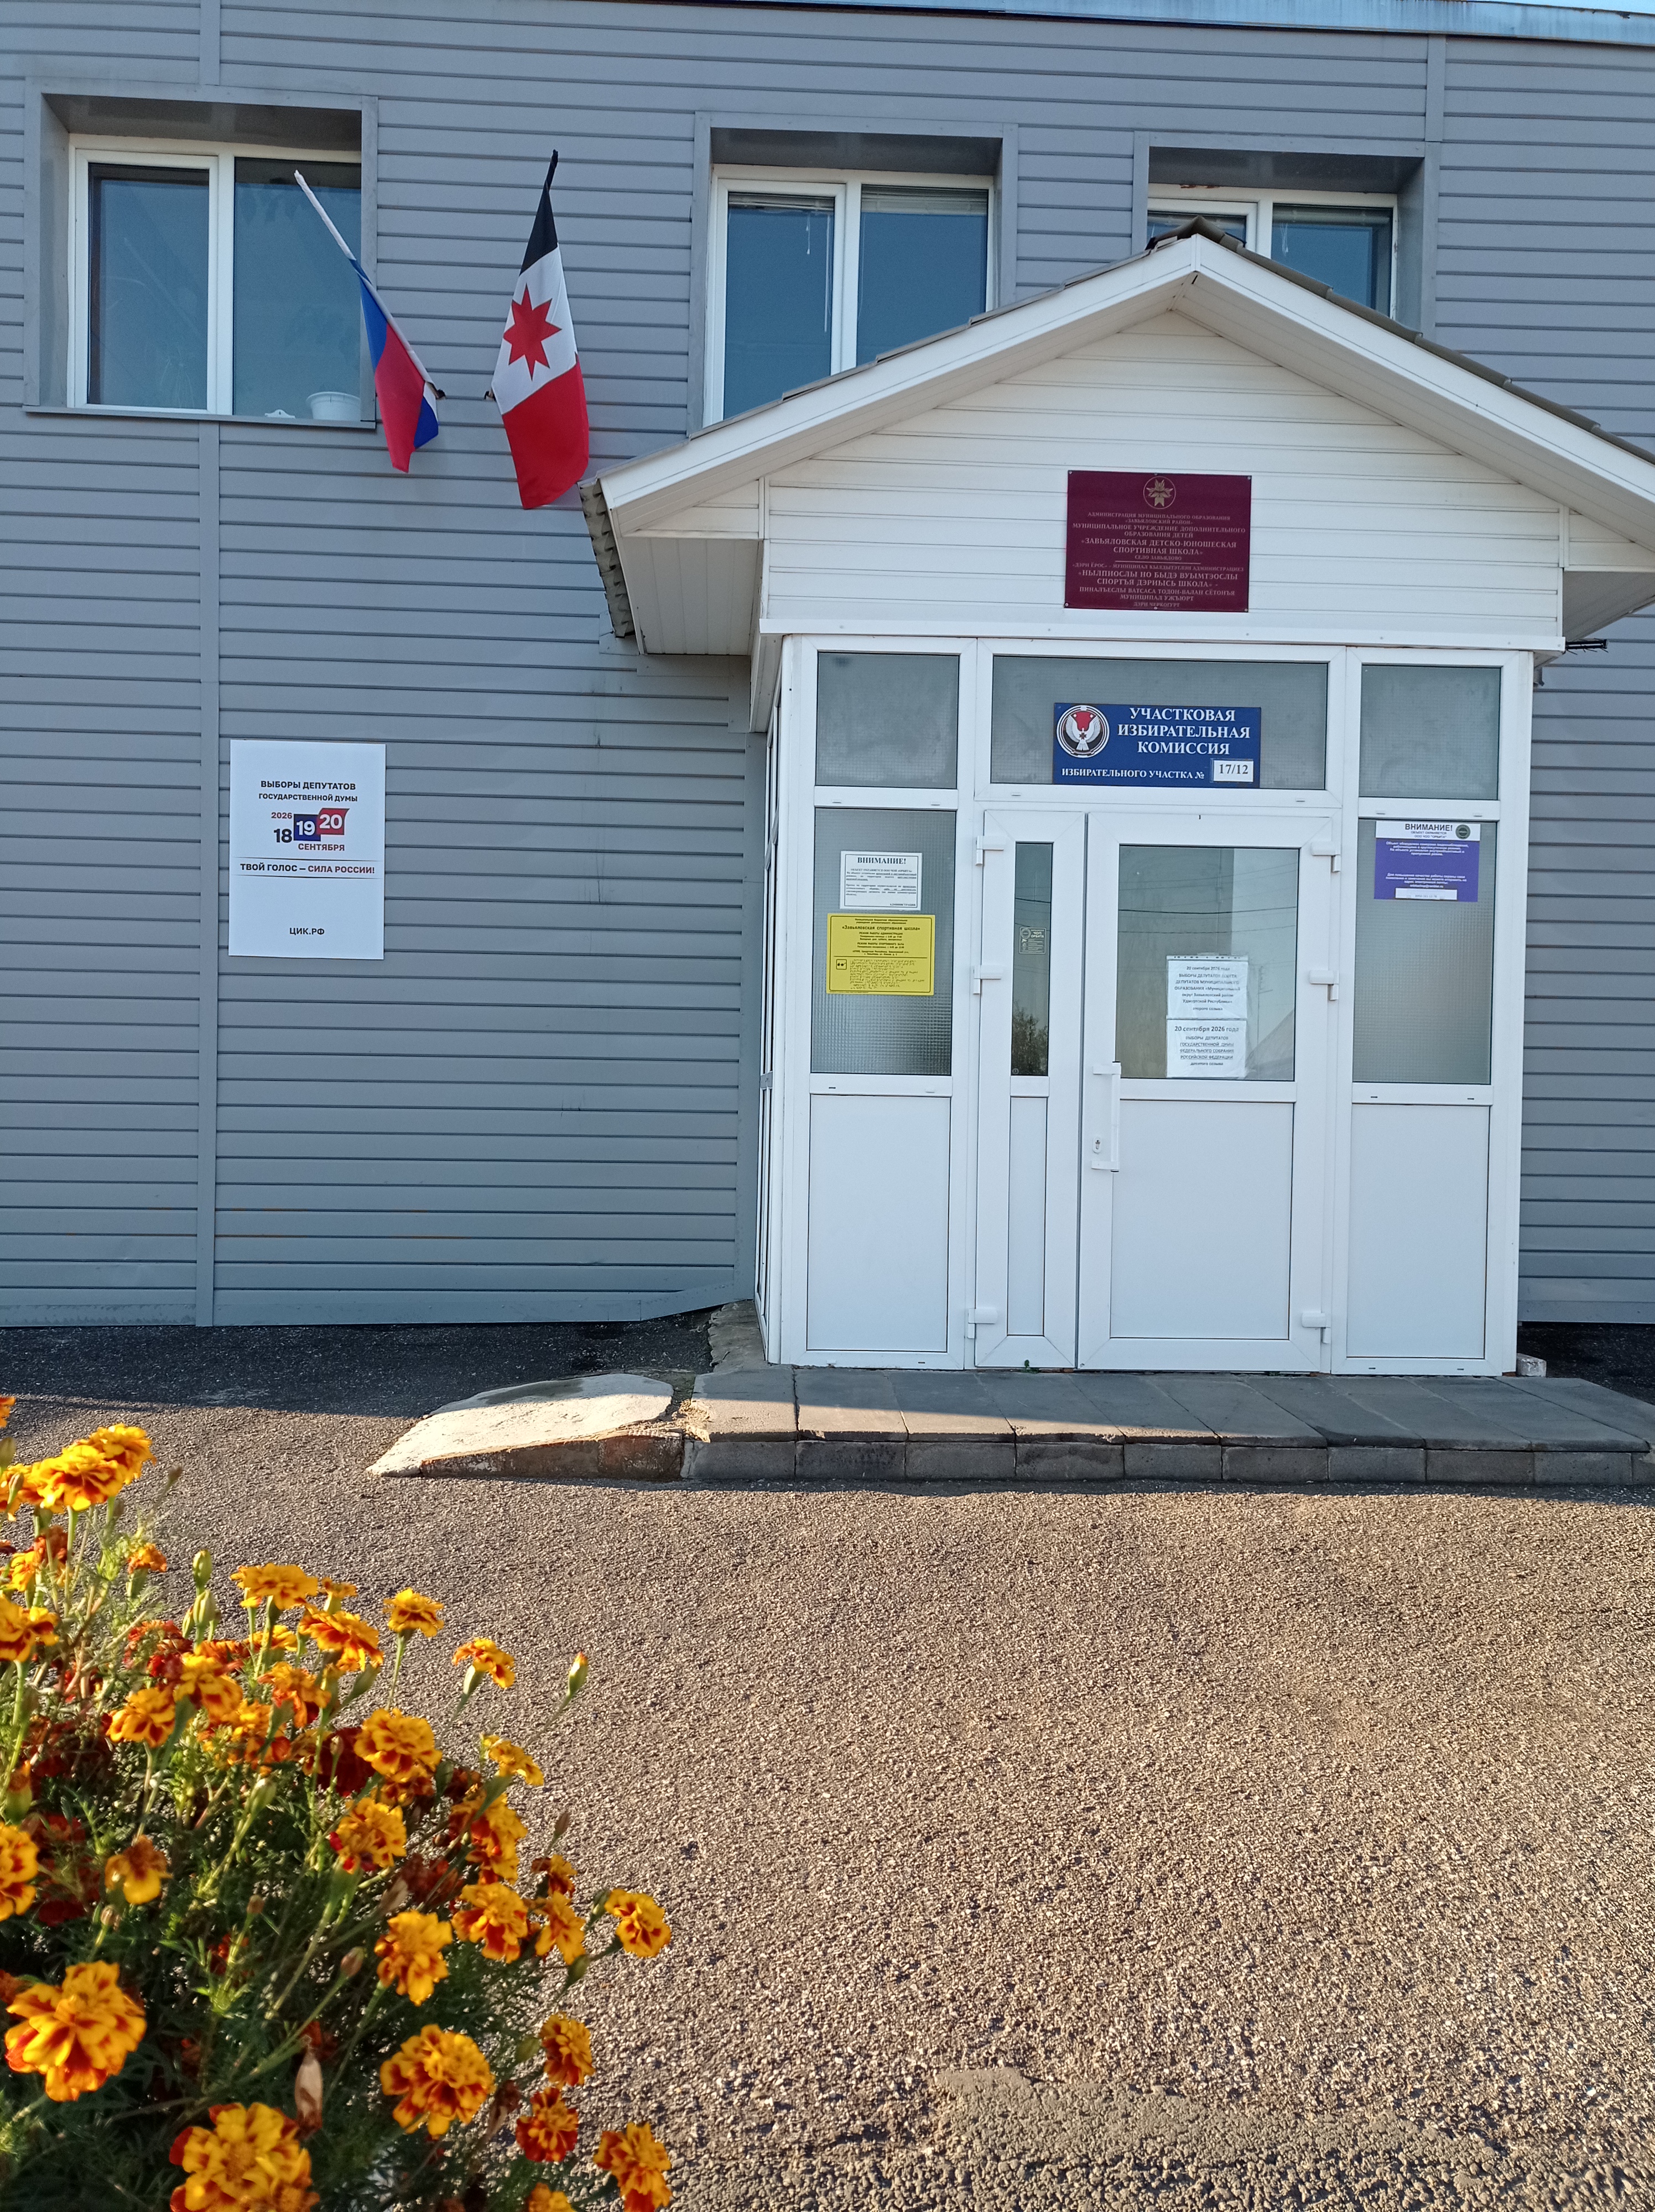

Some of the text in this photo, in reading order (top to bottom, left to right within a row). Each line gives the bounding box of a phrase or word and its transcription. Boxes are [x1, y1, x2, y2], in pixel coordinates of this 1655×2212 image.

[1130, 707, 1236, 722] УЧАСТКОВАЯ
[1117, 724, 1251, 739] ИЗБИРАТЕЛЬНАЯ
[1137, 742, 1230, 755] КОМИССИЯ
[1061, 768, 1146, 778] ИЗБИРАТЕЛЬНОГО
[1148, 770, 1193, 779] УЧАСТКА
[1219, 764, 1248, 775] 17/12
[303, 782, 356, 791] ДЕПУТАТОВ
[259, 792, 333, 801] ГОСУДАРСТВЕННОЙ
[273, 814, 342, 843] 18 19 20
[298, 843, 345, 852] СЕНТЯБРЯ
[240, 862, 265, 871] ТВОЙ
[267, 864, 298, 872] ГОЛОС
[289, 927, 325, 936] ЦИК.РФ
